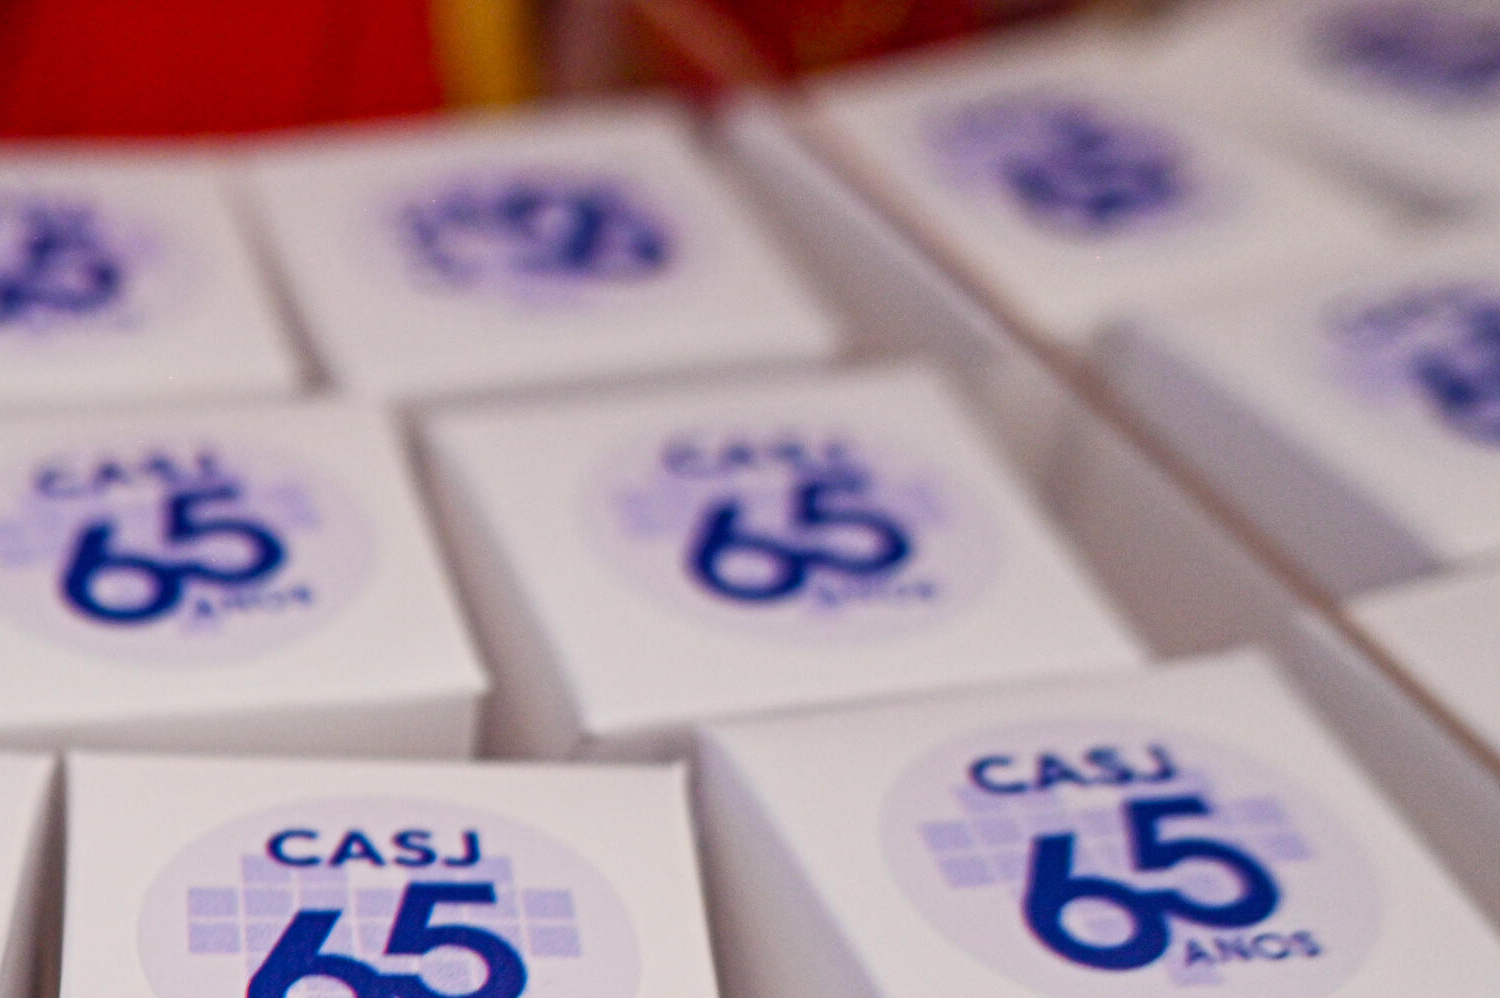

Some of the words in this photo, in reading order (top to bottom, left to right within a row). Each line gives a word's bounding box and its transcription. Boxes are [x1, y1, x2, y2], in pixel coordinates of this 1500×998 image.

[60, 484, 288, 627] 65
[688, 467, 912, 604] 65
[968, 745, 1180, 794] CASJ
[266, 828, 483, 868] CASJ
[1022, 793, 1282, 971] 65
[1184, 931, 1324, 967] ANOS
